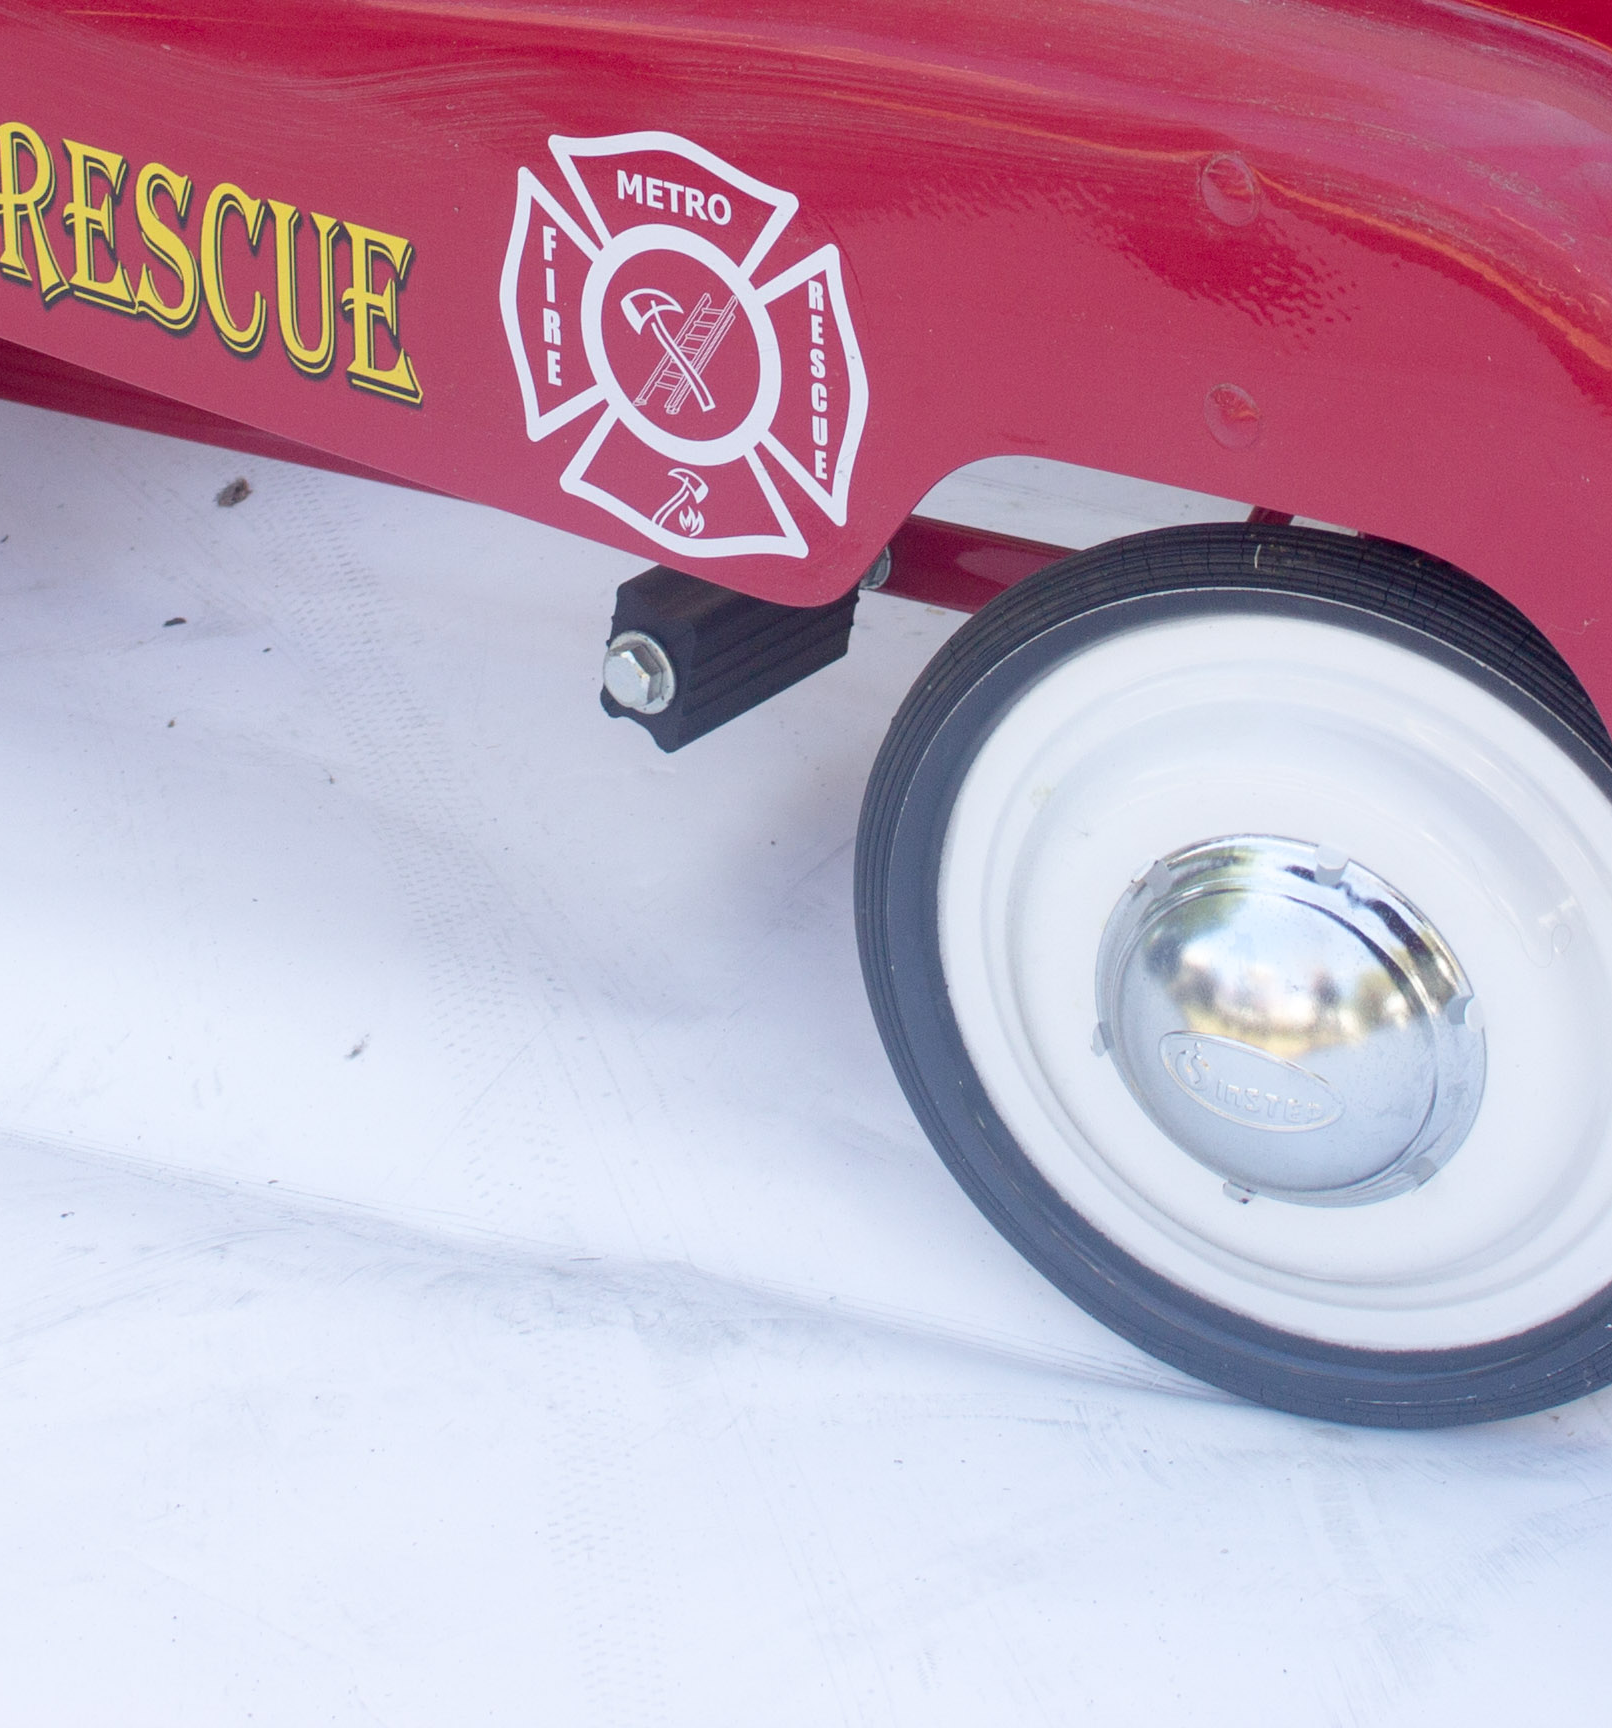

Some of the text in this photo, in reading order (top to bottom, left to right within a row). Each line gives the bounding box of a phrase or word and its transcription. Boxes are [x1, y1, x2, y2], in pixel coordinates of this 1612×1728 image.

[616, 169, 733, 227] METRO
[541, 224, 564, 388] FIRE
[806, 278, 829, 481] RESCUE
